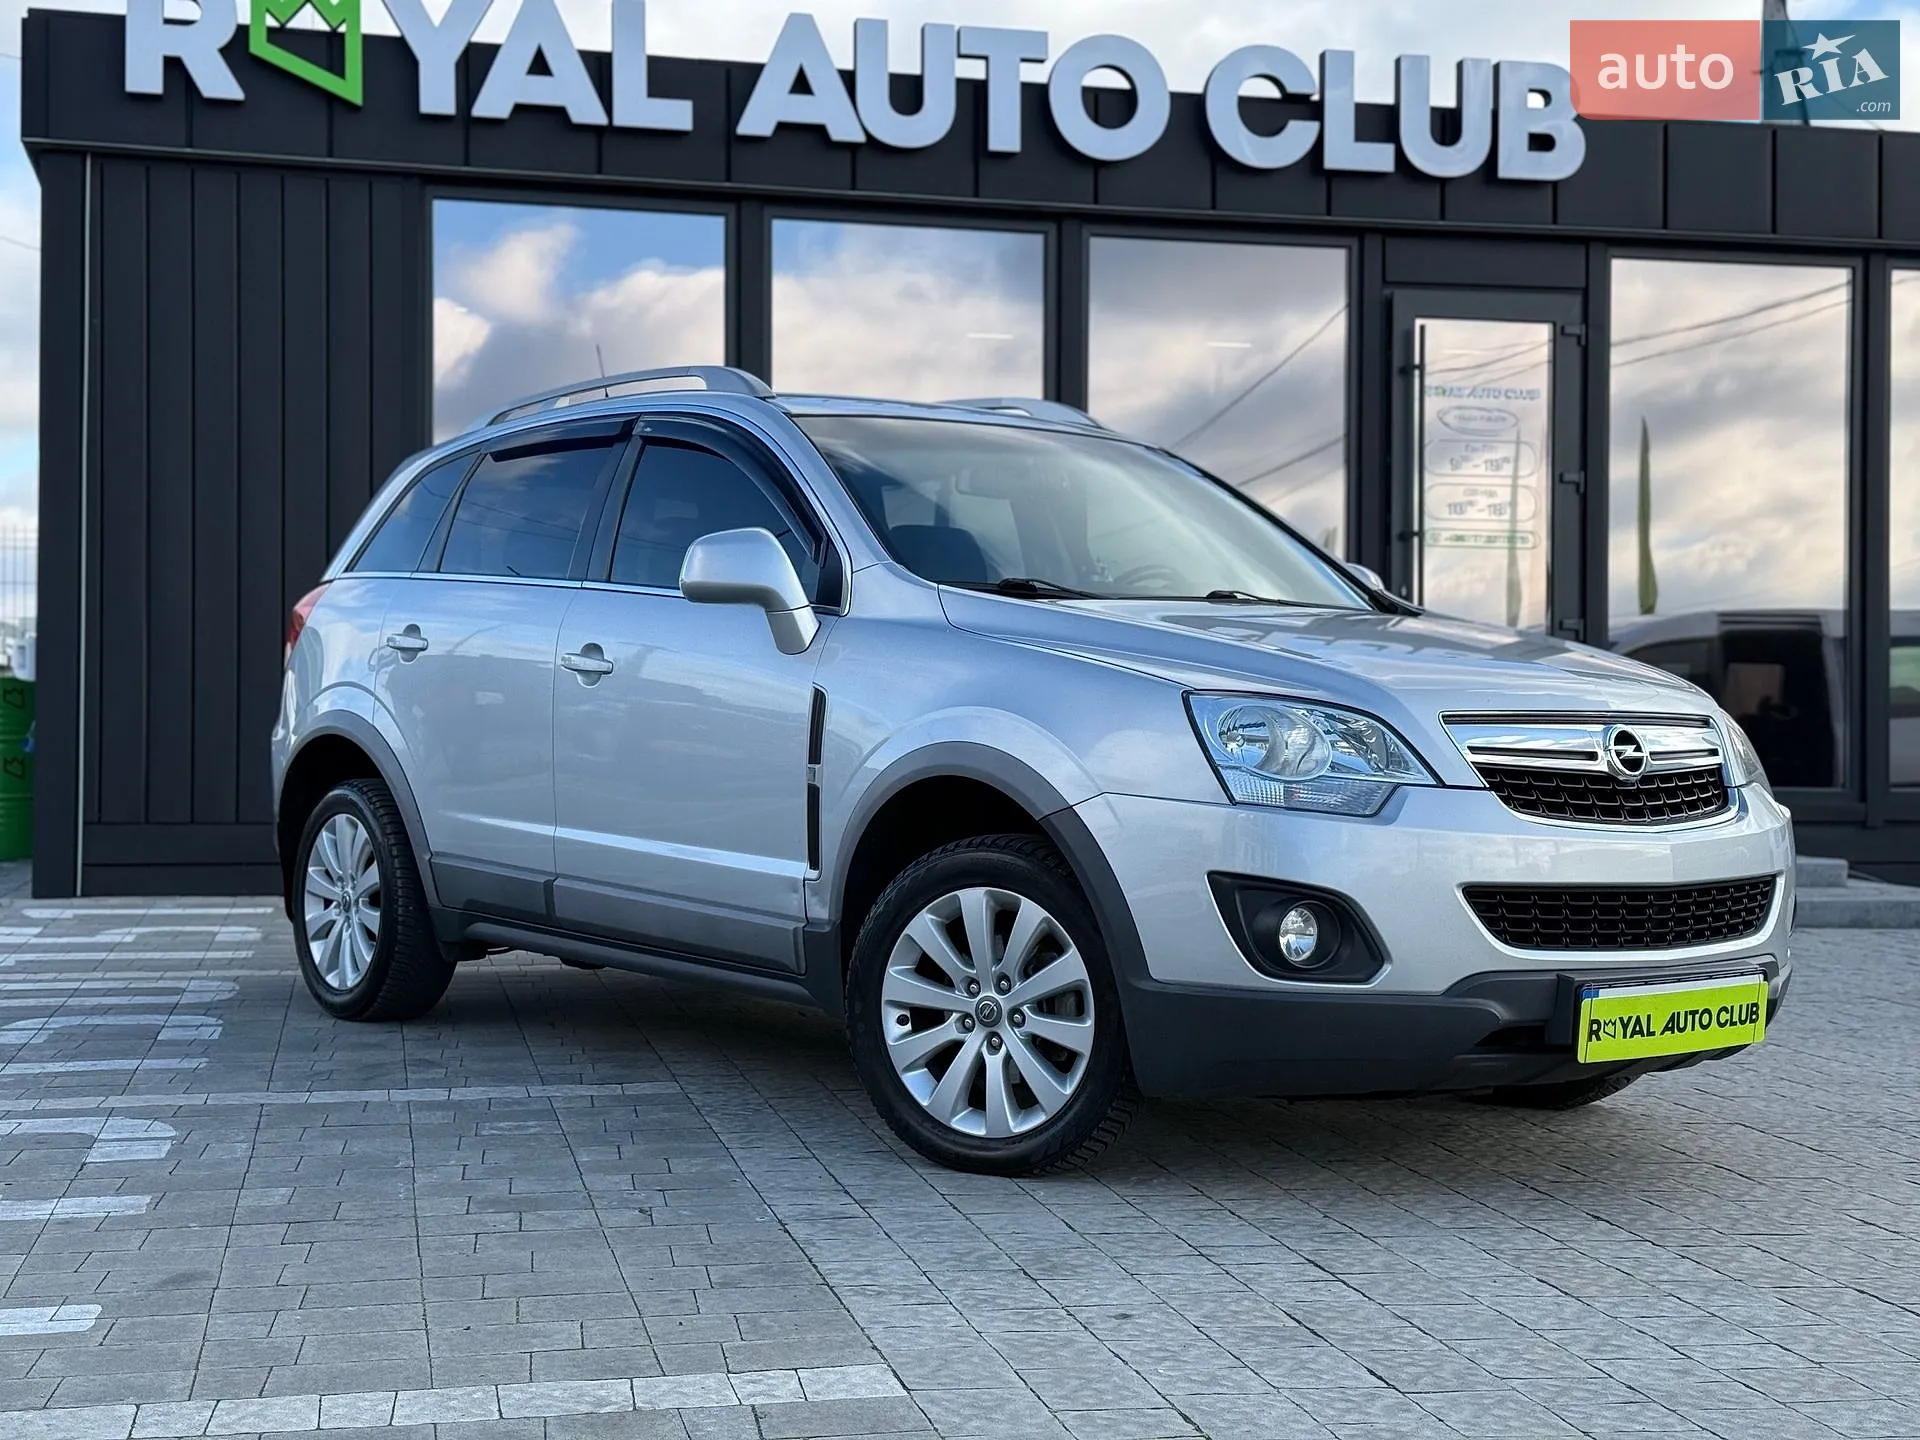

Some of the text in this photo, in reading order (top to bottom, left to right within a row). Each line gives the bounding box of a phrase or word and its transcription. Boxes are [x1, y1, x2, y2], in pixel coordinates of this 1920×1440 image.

[736, 13, 1171, 162] AUTO
[1202, 44, 1587, 182] CLUB
[1660, 1007, 1713, 1036] AUTO
[1715, 1002, 1760, 1029] CLUB
